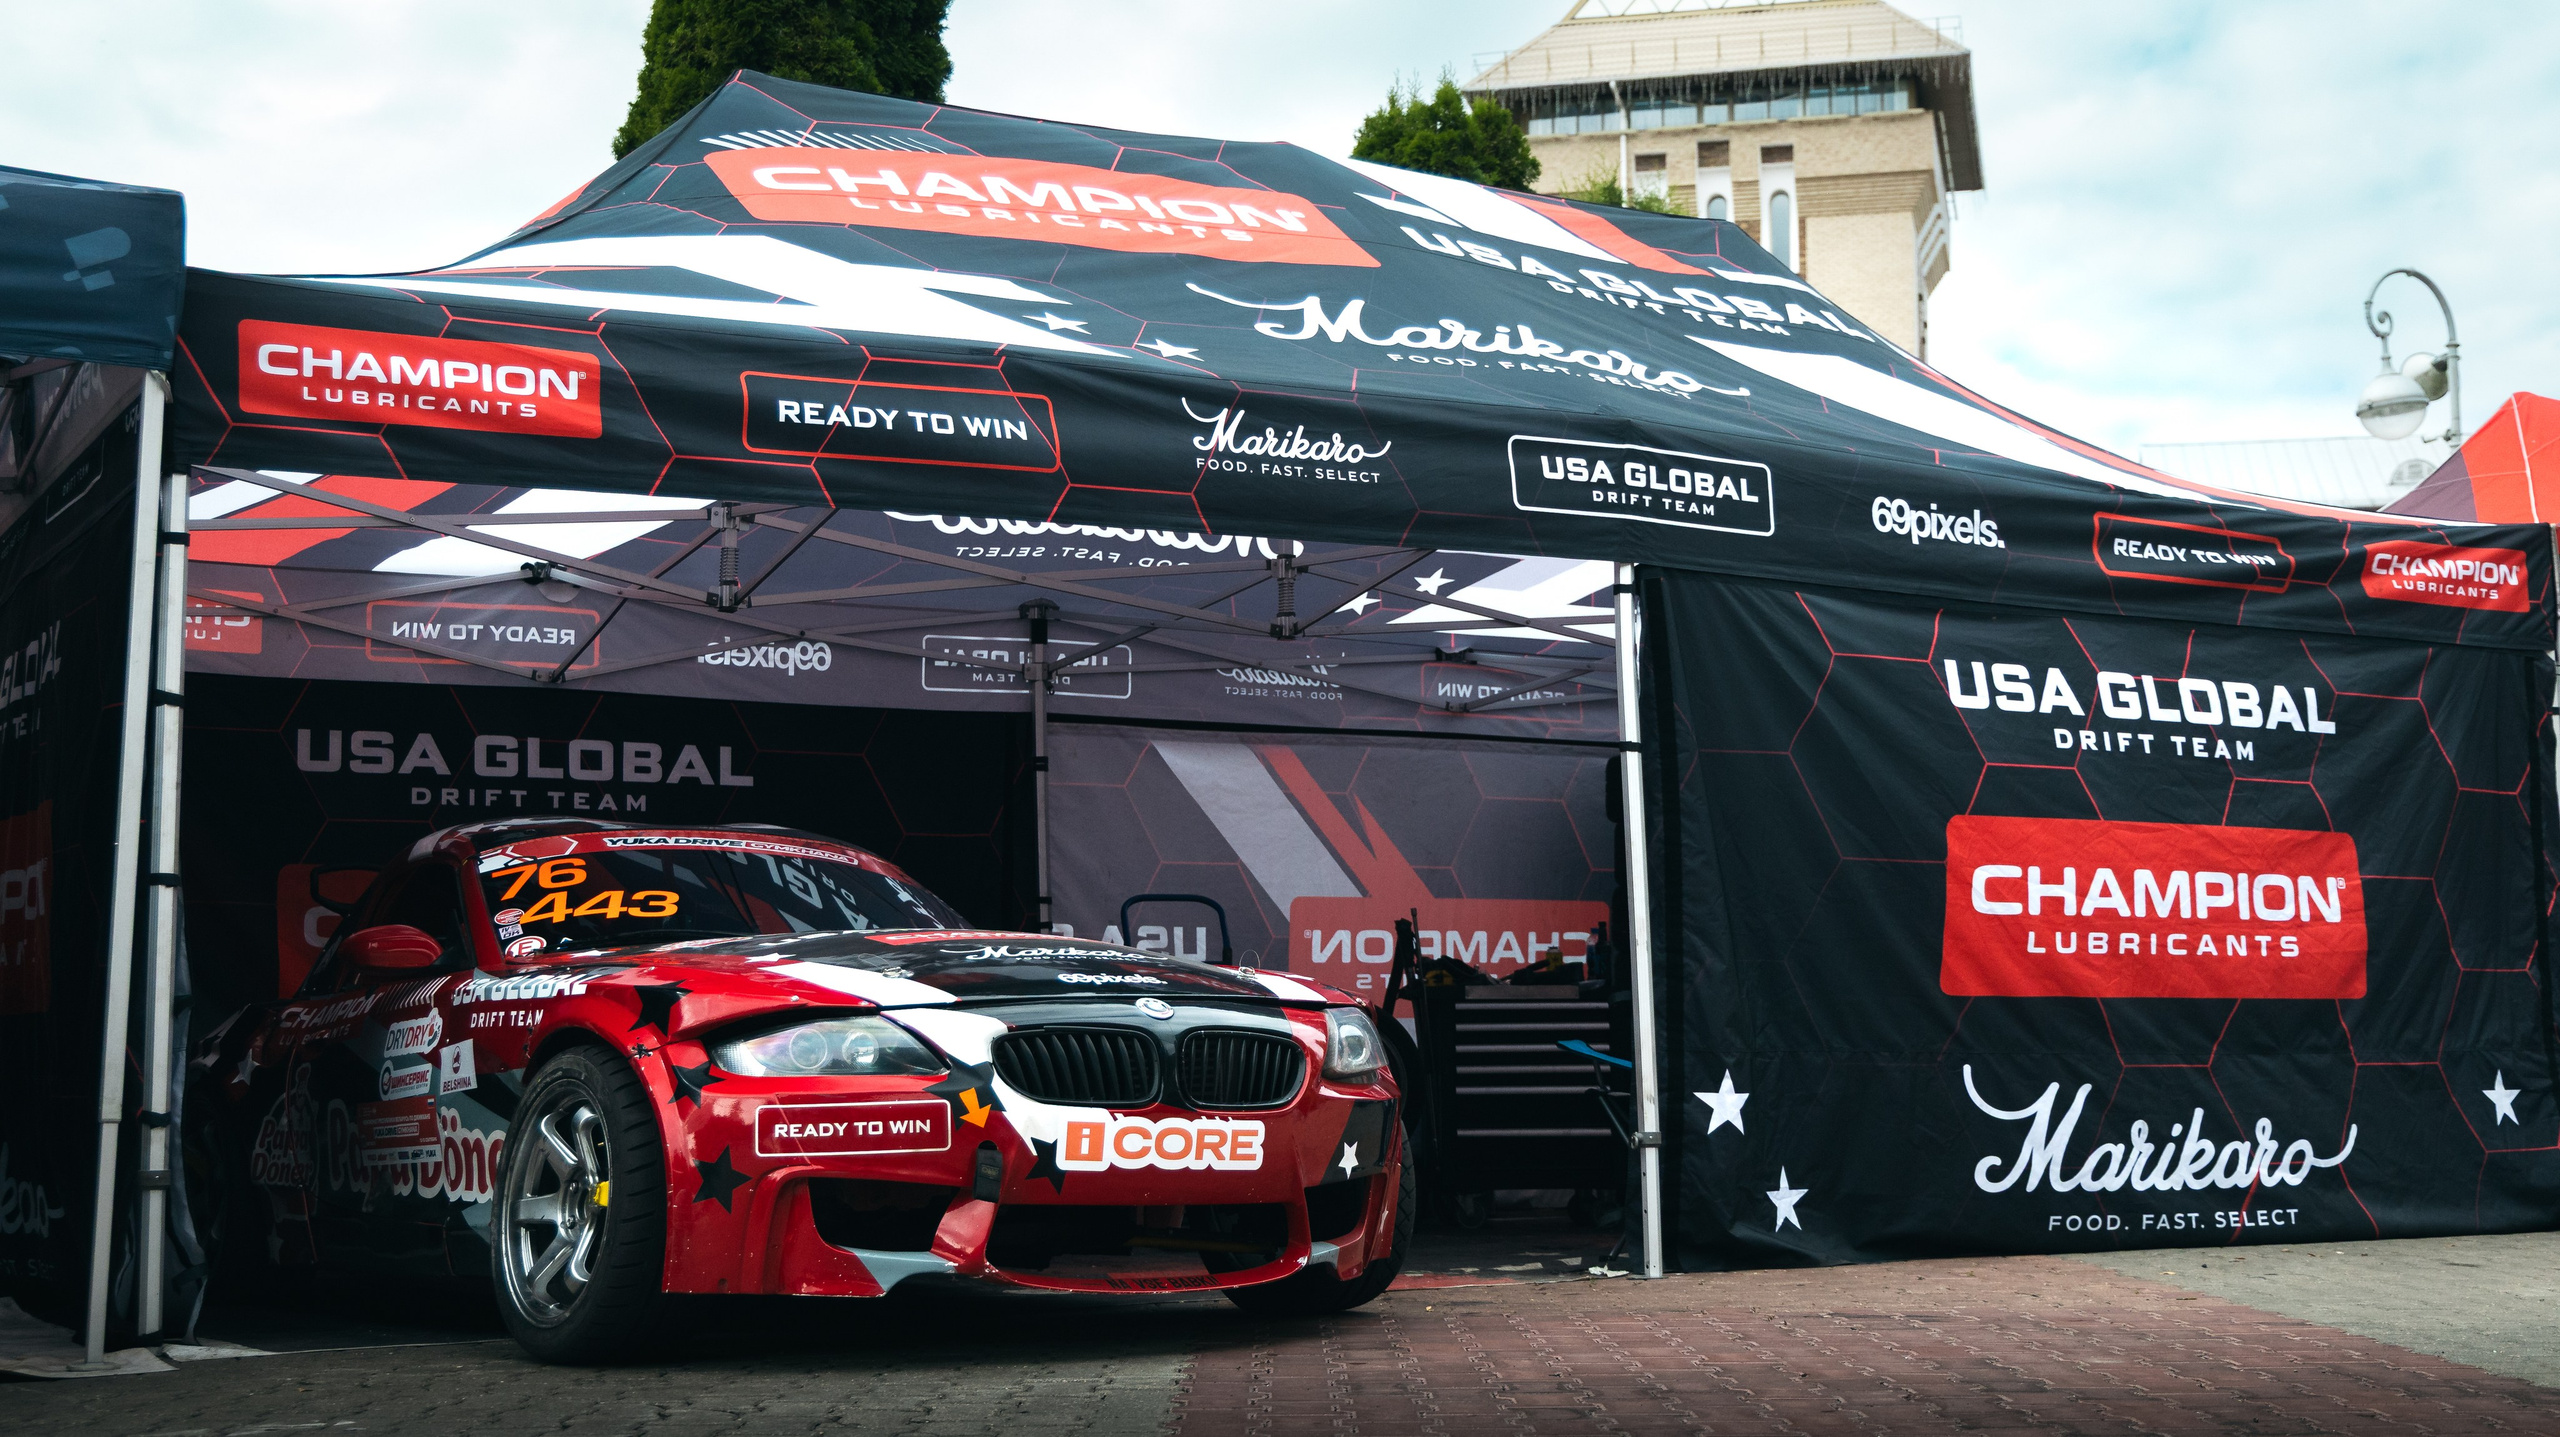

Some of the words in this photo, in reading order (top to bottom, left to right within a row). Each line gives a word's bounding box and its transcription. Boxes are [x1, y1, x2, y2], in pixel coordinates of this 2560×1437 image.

[848, 197, 1254, 242] LUBRICANTS
[1400, 226, 1577, 286] USA
[1576, 268, 1876, 343] GLOBAL
[1547, 281, 1671, 315] DRIFT
[1682, 309, 1790, 336] TEAM
[1185, 282, 1750, 397] Marikaro
[1387, 352, 1490, 368] FOOD.
[1498, 360, 1582, 378] FAST.
[1588, 375, 1693, 400] SELECT
[303, 387, 536, 417] LUBRICANTS
[779, 400, 897, 430] READY
[907, 411, 954, 434] TO
[962, 416, 1027, 440] WIN
[1182, 397, 1391, 463] Marikaro
[1197, 457, 1253, 474] FOOD.
[1262, 463, 1308, 479] FAST.
[1315, 468, 1380, 483] SELECT
[1541, 456, 1611, 485] USA
[1623, 462, 1759, 503] GLOBAL
[1593, 490, 1652, 507] DRIFT
[1662, 497, 1715, 516] TEAM
[1872, 496, 2005, 548] 69pixels.
[2114, 538, 2186, 562] READY
[2191, 550, 2227, 563] TO
[2226, 554, 2276, 566] WIN
[2392, 579, 2498, 599] LUBRICANTS
[1944, 659, 2085, 716] USA
[2096, 670, 2336, 734] GLOBAL
[297, 729, 451, 775] USA
[470, 735, 754, 787] GLOBAL
[2054, 728, 2154, 753] DRIFT
[2170, 736, 2253, 761] TEAM
[412, 787, 527, 807] DRIFT
[548, 792, 646, 811] TEAM
[606, 838, 670, 846] YUKA
[673, 838, 743, 847] DRIVE
[750, 842, 850, 862] GYMKHANA
[491, 857, 588, 901] 76
[519, 890, 680, 925] 443
[940, 946, 1168, 960] Marikaro
[2027, 931, 2299, 957] LUBRICANTS
[453, 978, 499, 1006] USA
[491, 974, 592, 1000] GLOBAL
[280, 992, 385, 1028] CHAMPION
[471, 1012, 505, 1028] DRIFT
[511, 1009, 543, 1026] TEAM
[443, 1076, 472, 1093] BELSHINA
[774, 1123, 848, 1137] READY
[854, 1121, 883, 1135] TO
[889, 1120, 930, 1134] WIN
[1963, 1064, 2357, 1193] Marikaro
[2049, 1215, 2129, 1231] FOOD.
[2142, 1213, 2204, 1229] FAST.
[2215, 1209, 2298, 1228] SELECT
